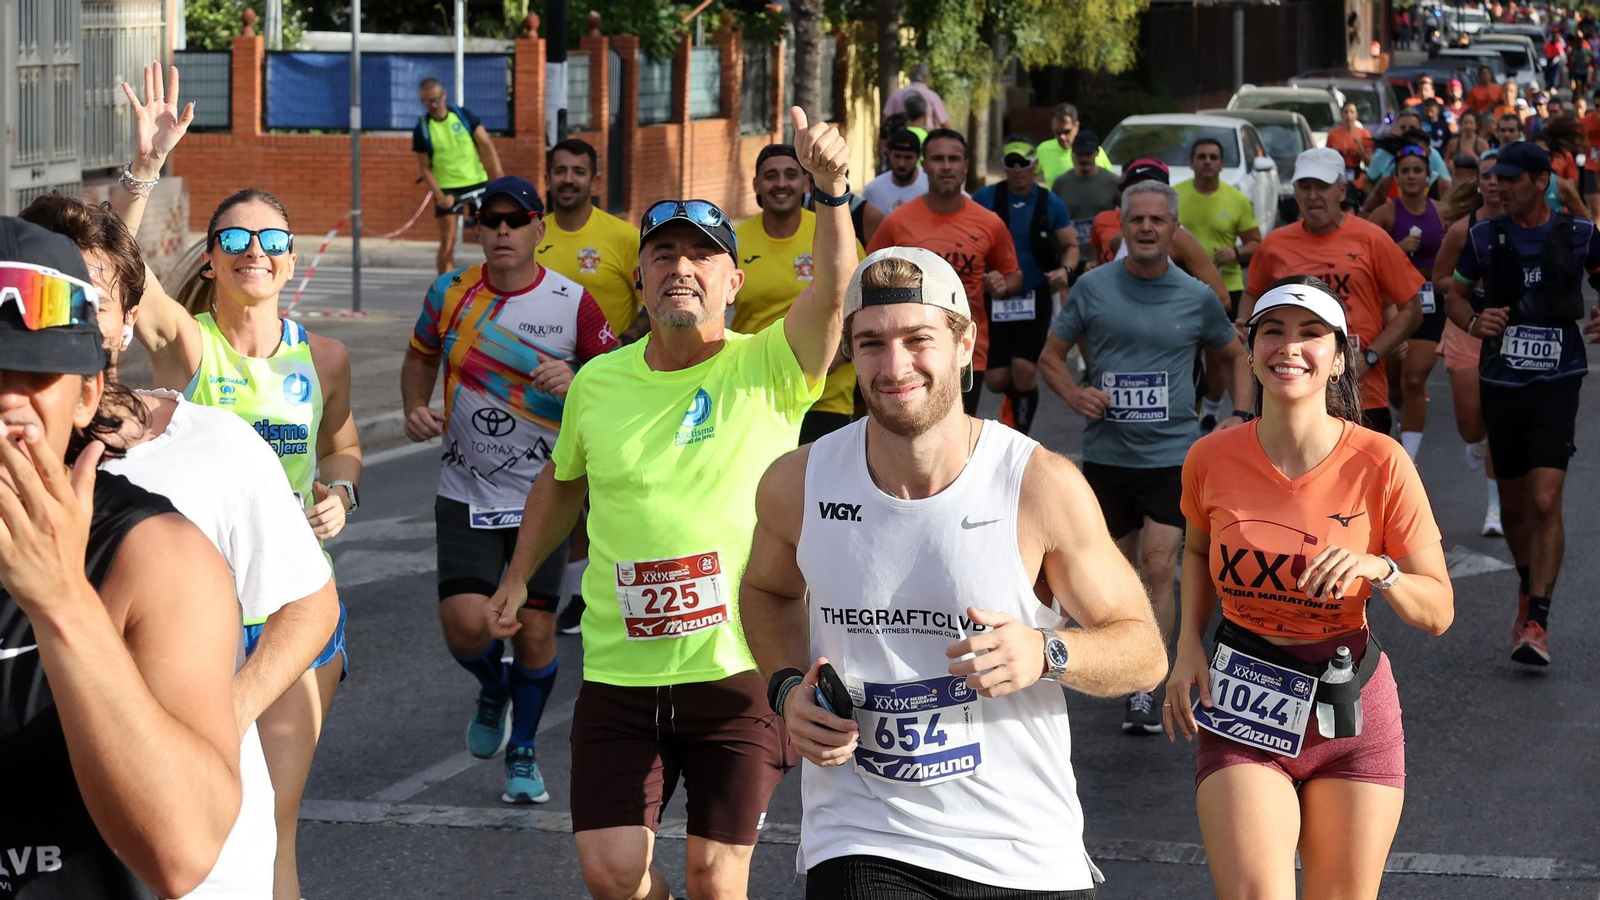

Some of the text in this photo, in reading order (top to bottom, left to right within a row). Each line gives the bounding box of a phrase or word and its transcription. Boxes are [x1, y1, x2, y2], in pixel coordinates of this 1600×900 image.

[1511, 340, 1552, 357] 1100
[1113, 389, 1158, 406] 1116
[674, 426, 715, 441] Atletismo
[280, 442, 307, 457] Jerez
[471, 441, 516, 456] TOMAX
[818, 501, 862, 522] VIGY.
[641, 582, 700, 615] 225
[1221, 585, 1255, 599] MEDIA
[1257, 591, 1322, 609] MARATÓN
[1324, 602, 1342, 610] DE
[881, 627, 910, 635] FITNESS
[912, 628, 944, 636] TRAINING
[944, 631, 961, 640] CLVB
[955, 681, 966, 691] 21
[1218, 678, 1289, 727] 1044
[875, 712, 947, 752] 654
